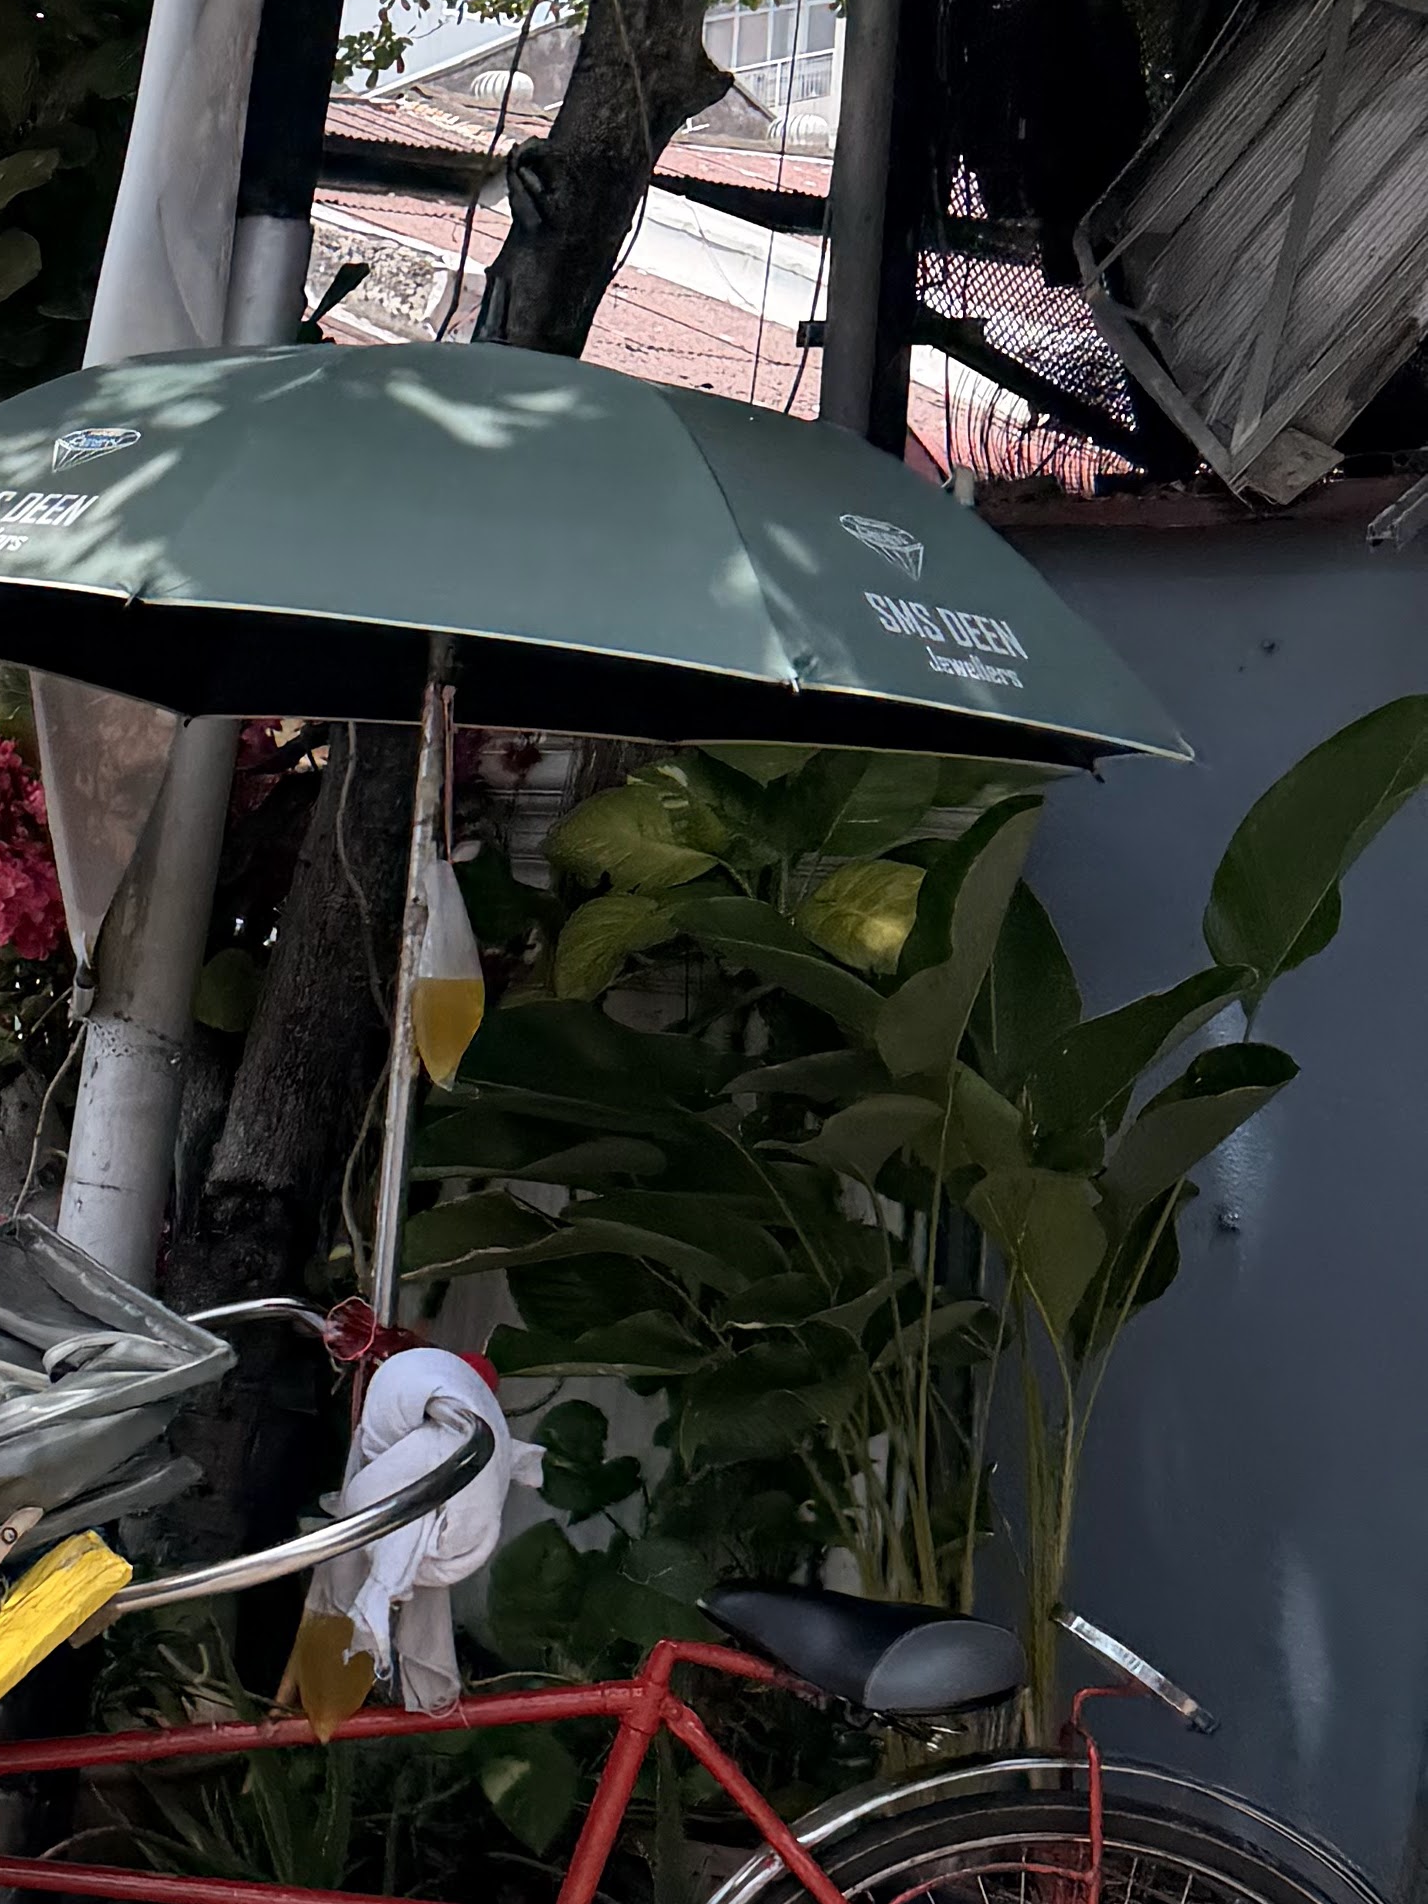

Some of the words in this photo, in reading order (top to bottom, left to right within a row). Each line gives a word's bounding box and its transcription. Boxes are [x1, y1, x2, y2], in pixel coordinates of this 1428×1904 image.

[0, 491, 99, 527] DEEN
[863, 591, 945, 642] SMS
[935, 606, 1029, 660] DEEN
[926, 645, 1024, 689] Jewellers
